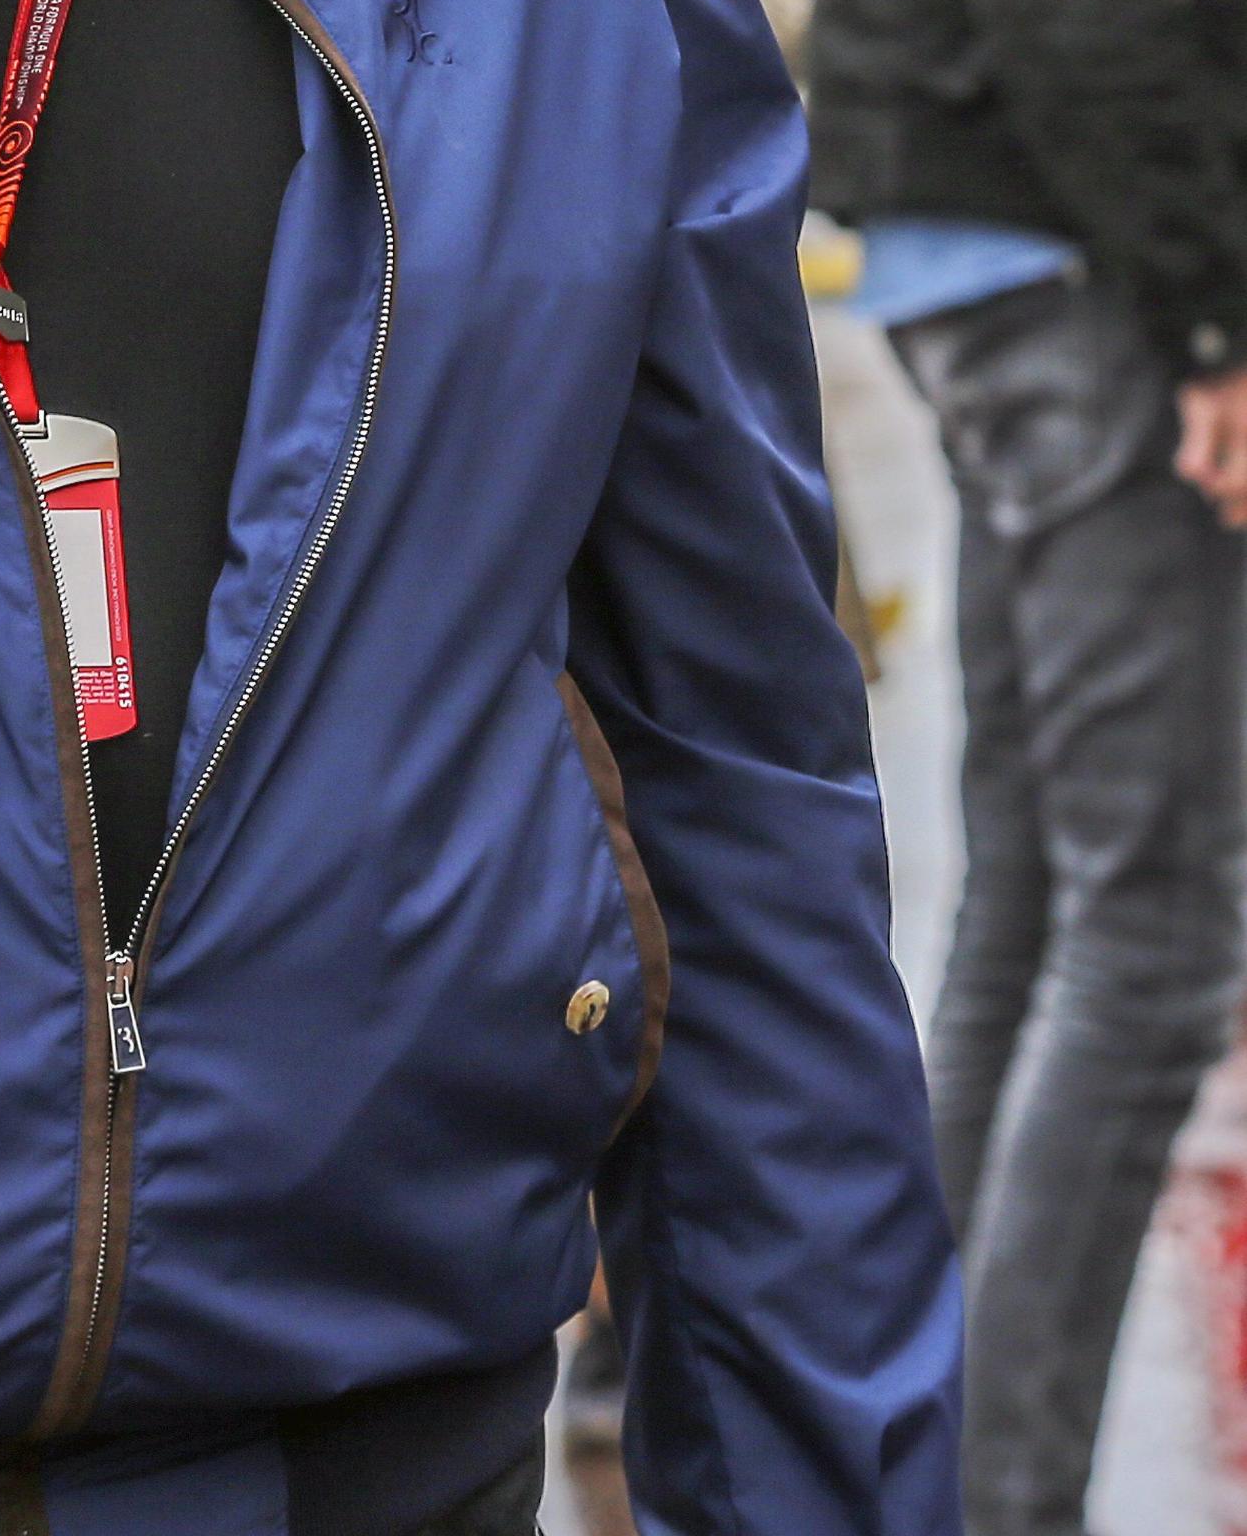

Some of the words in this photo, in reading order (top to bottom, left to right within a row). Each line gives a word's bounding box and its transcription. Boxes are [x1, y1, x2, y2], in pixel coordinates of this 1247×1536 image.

[36, 6, 60, 52] FORMULA
[30, 54, 46, 74] ONE
[115, 656, 133, 708] 610415
